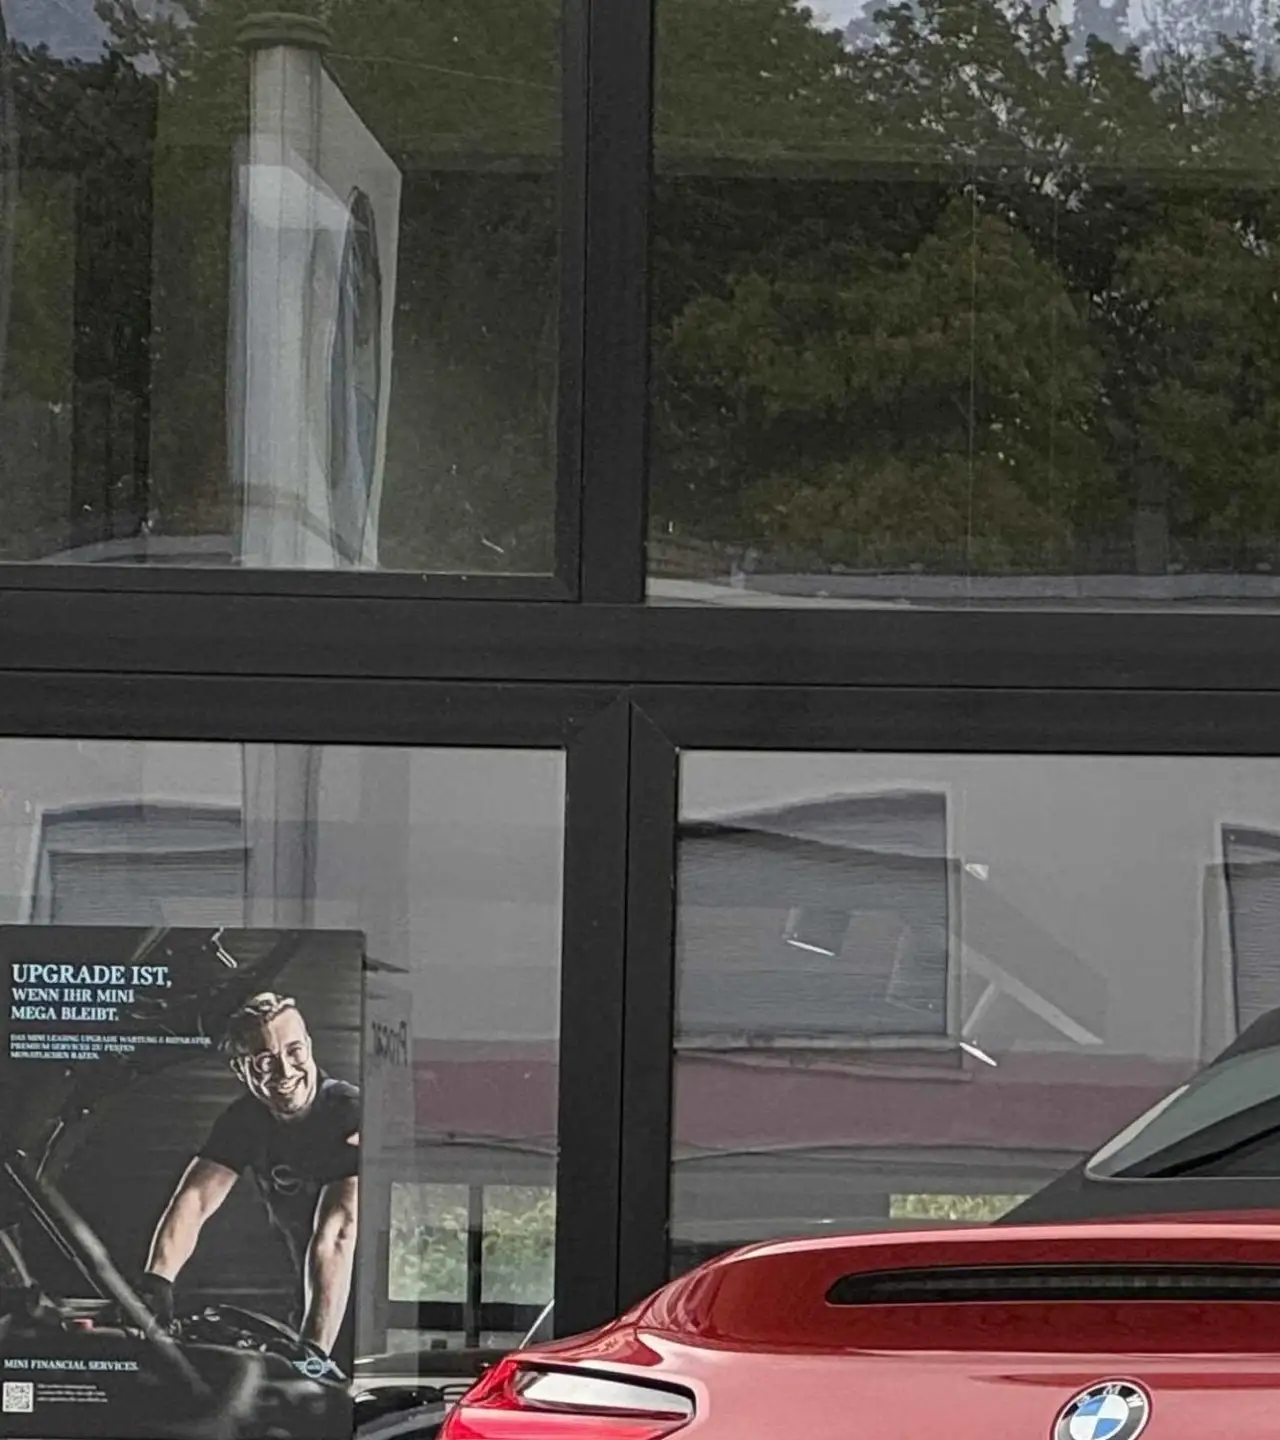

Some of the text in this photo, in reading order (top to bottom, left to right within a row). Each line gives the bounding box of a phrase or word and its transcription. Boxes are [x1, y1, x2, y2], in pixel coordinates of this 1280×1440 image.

[12, 964, 172, 988] UPGRADE IST,
[12, 988, 135, 1003] WENN IHR MINI
[11, 1006, 119, 1021] MEGA BLEIBT.
[4, 1359, 28, 1369] MINI
[31, 1360, 87, 1370] FINANCIAL
